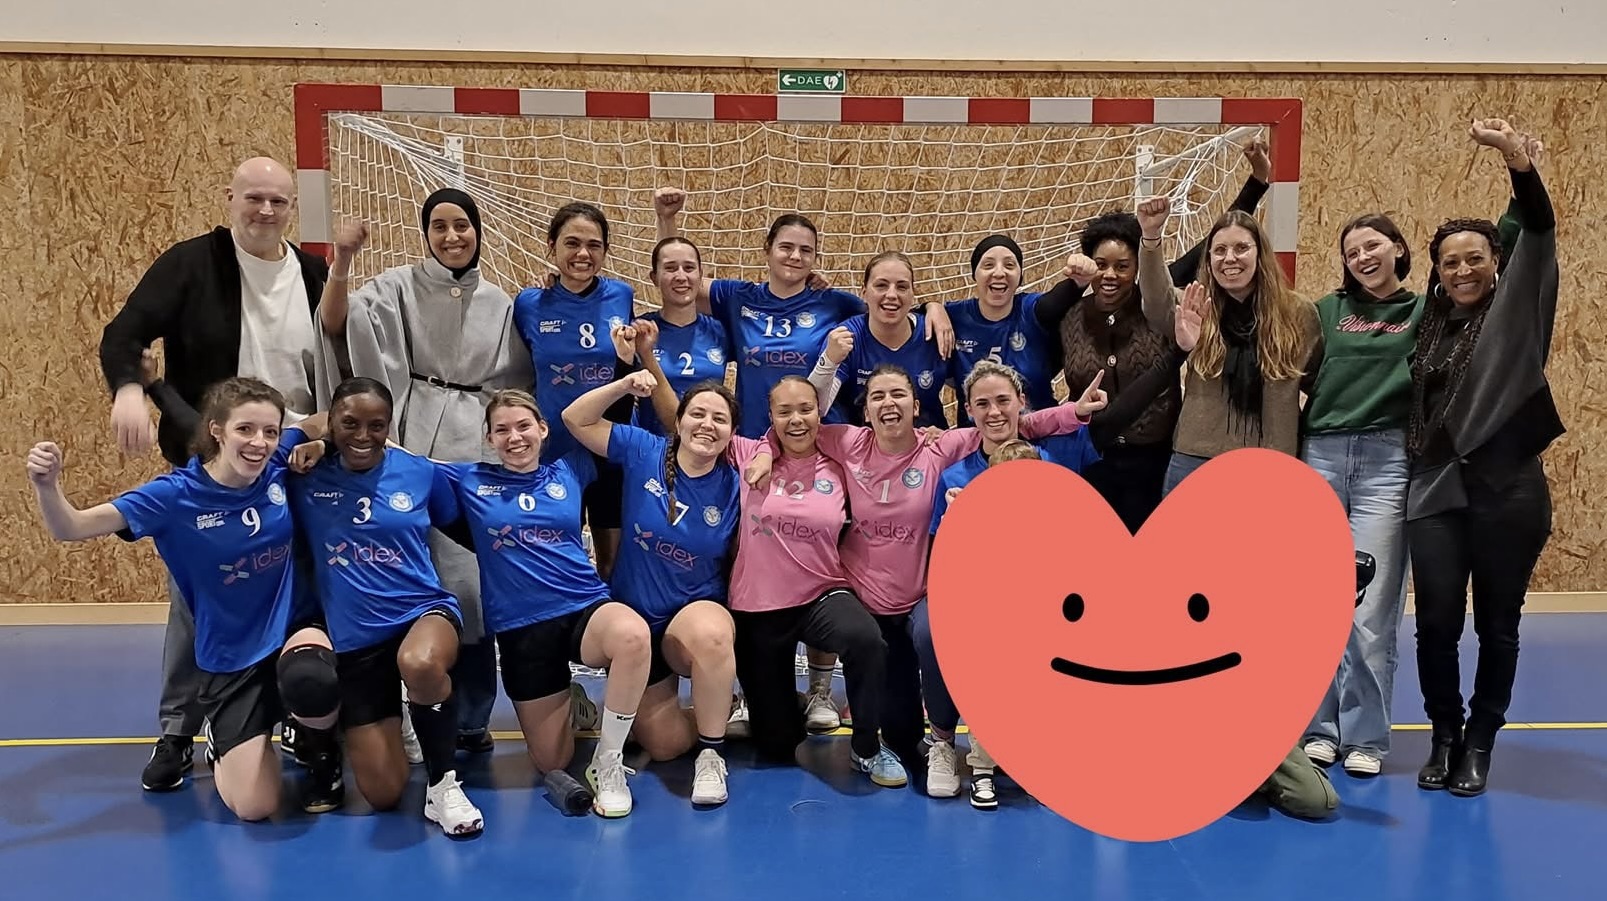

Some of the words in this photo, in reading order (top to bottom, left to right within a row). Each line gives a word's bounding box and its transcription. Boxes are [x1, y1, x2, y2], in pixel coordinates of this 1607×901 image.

[797, 76, 822, 85] DAE
[579, 323, 596, 348] 8
[762, 315, 792, 338] 13
[679, 352, 695, 375] 2
[765, 347, 808, 365] idex
[987, 346, 1002, 365] 5
[774, 479, 805, 500] 12
[876, 480, 890, 504] 1
[352, 497, 372, 524] 3
[518, 493, 536, 512] 6
[672, 501, 690, 526] 7
[241, 507, 260, 537] 9
[777, 516, 820, 541] idex
[874, 521, 916, 540] idex
[518, 525, 563, 543] idex
[352, 542, 403, 563] idex
[655, 537, 699, 567] idex
